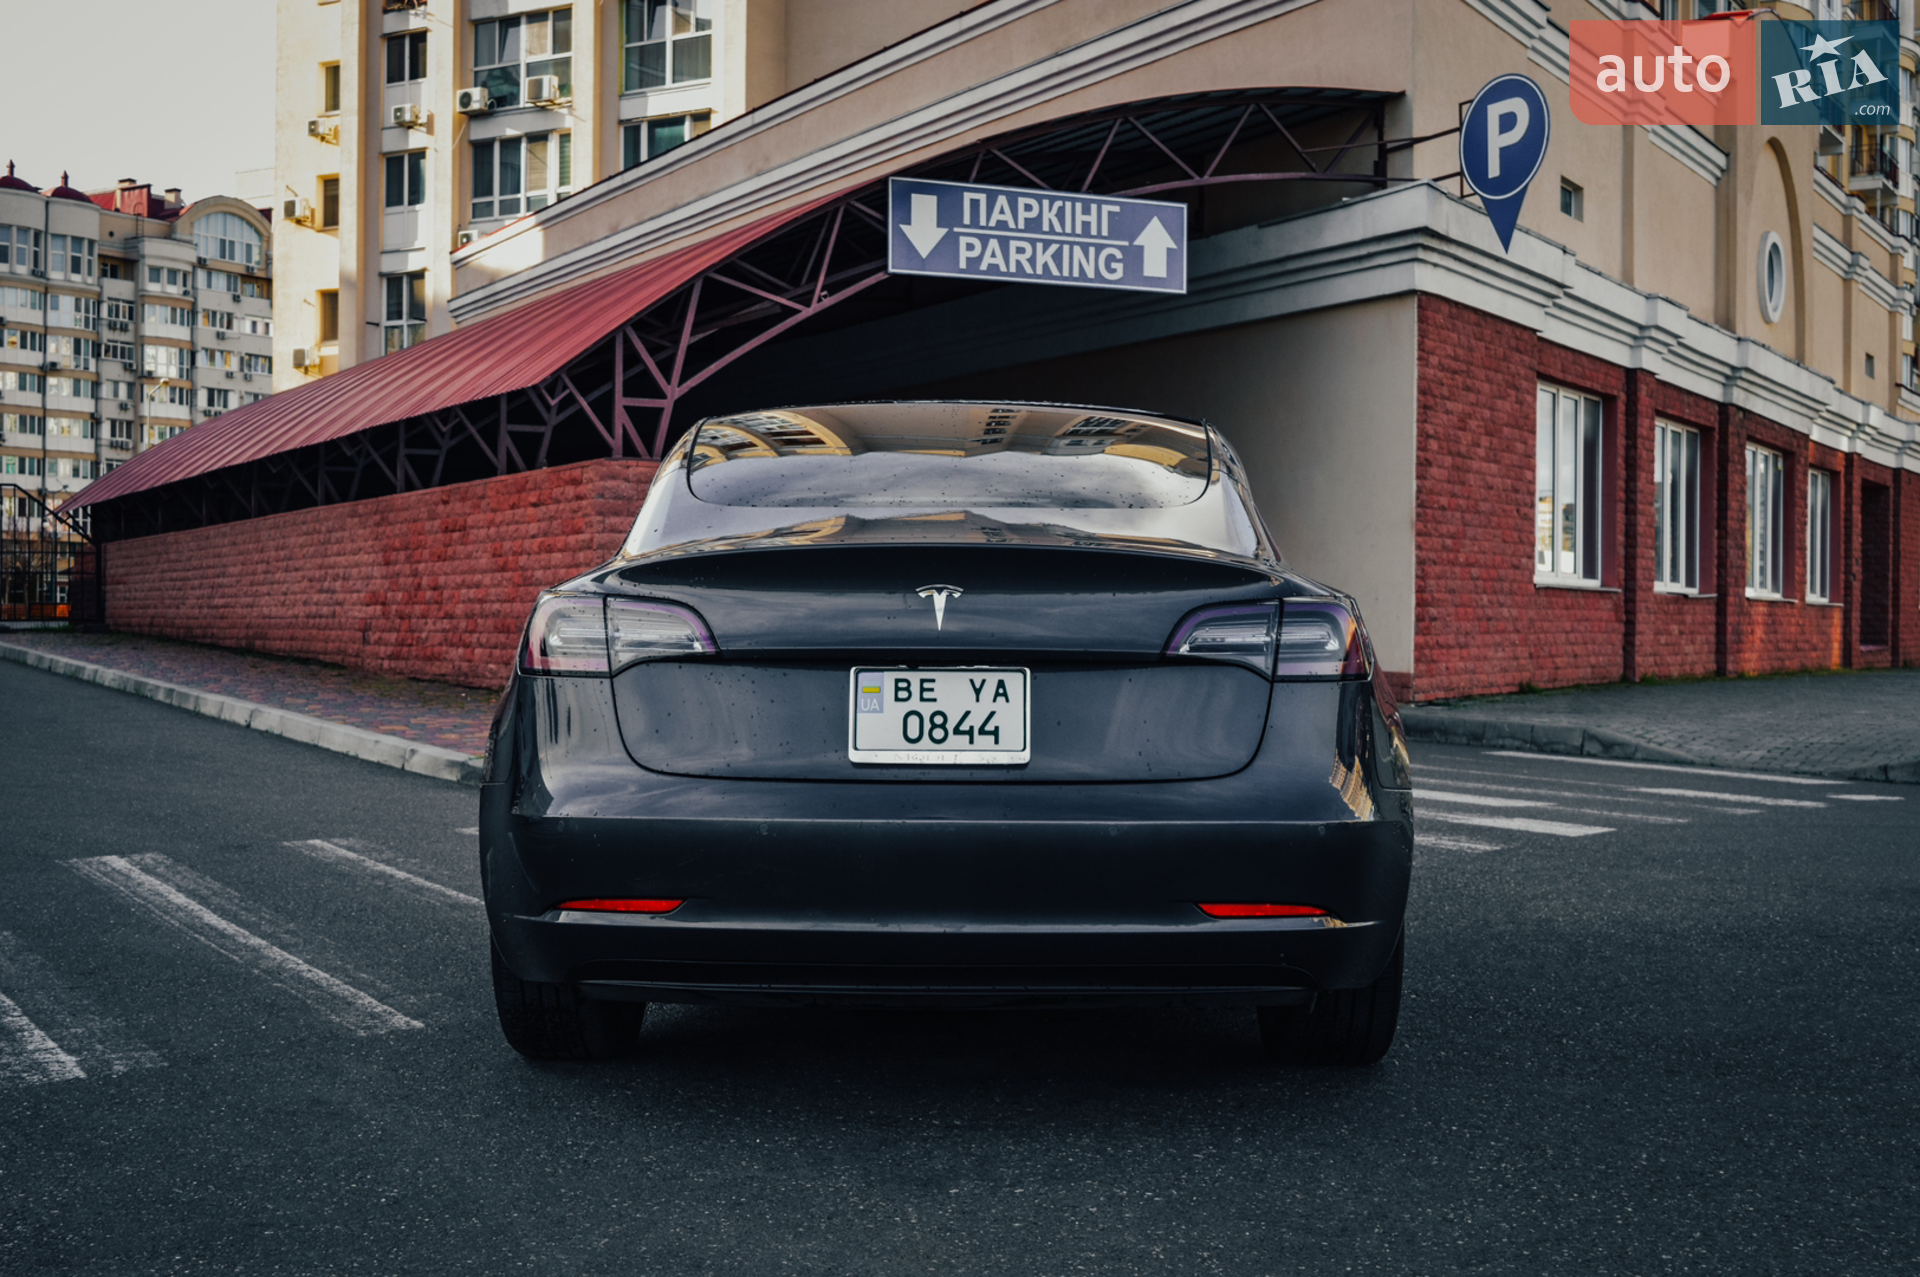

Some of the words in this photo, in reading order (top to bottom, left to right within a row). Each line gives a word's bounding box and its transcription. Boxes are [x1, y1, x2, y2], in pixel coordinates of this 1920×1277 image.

[1487, 97, 1530, 179] P
[963, 192, 1121, 236] ПАРКІНГ
[959, 236, 1124, 280] PARKING
[861, 699, 880, 711] UA
[894, 678, 937, 702] BE
[969, 678, 1010, 703] YA
[902, 710, 999, 745] 0844
